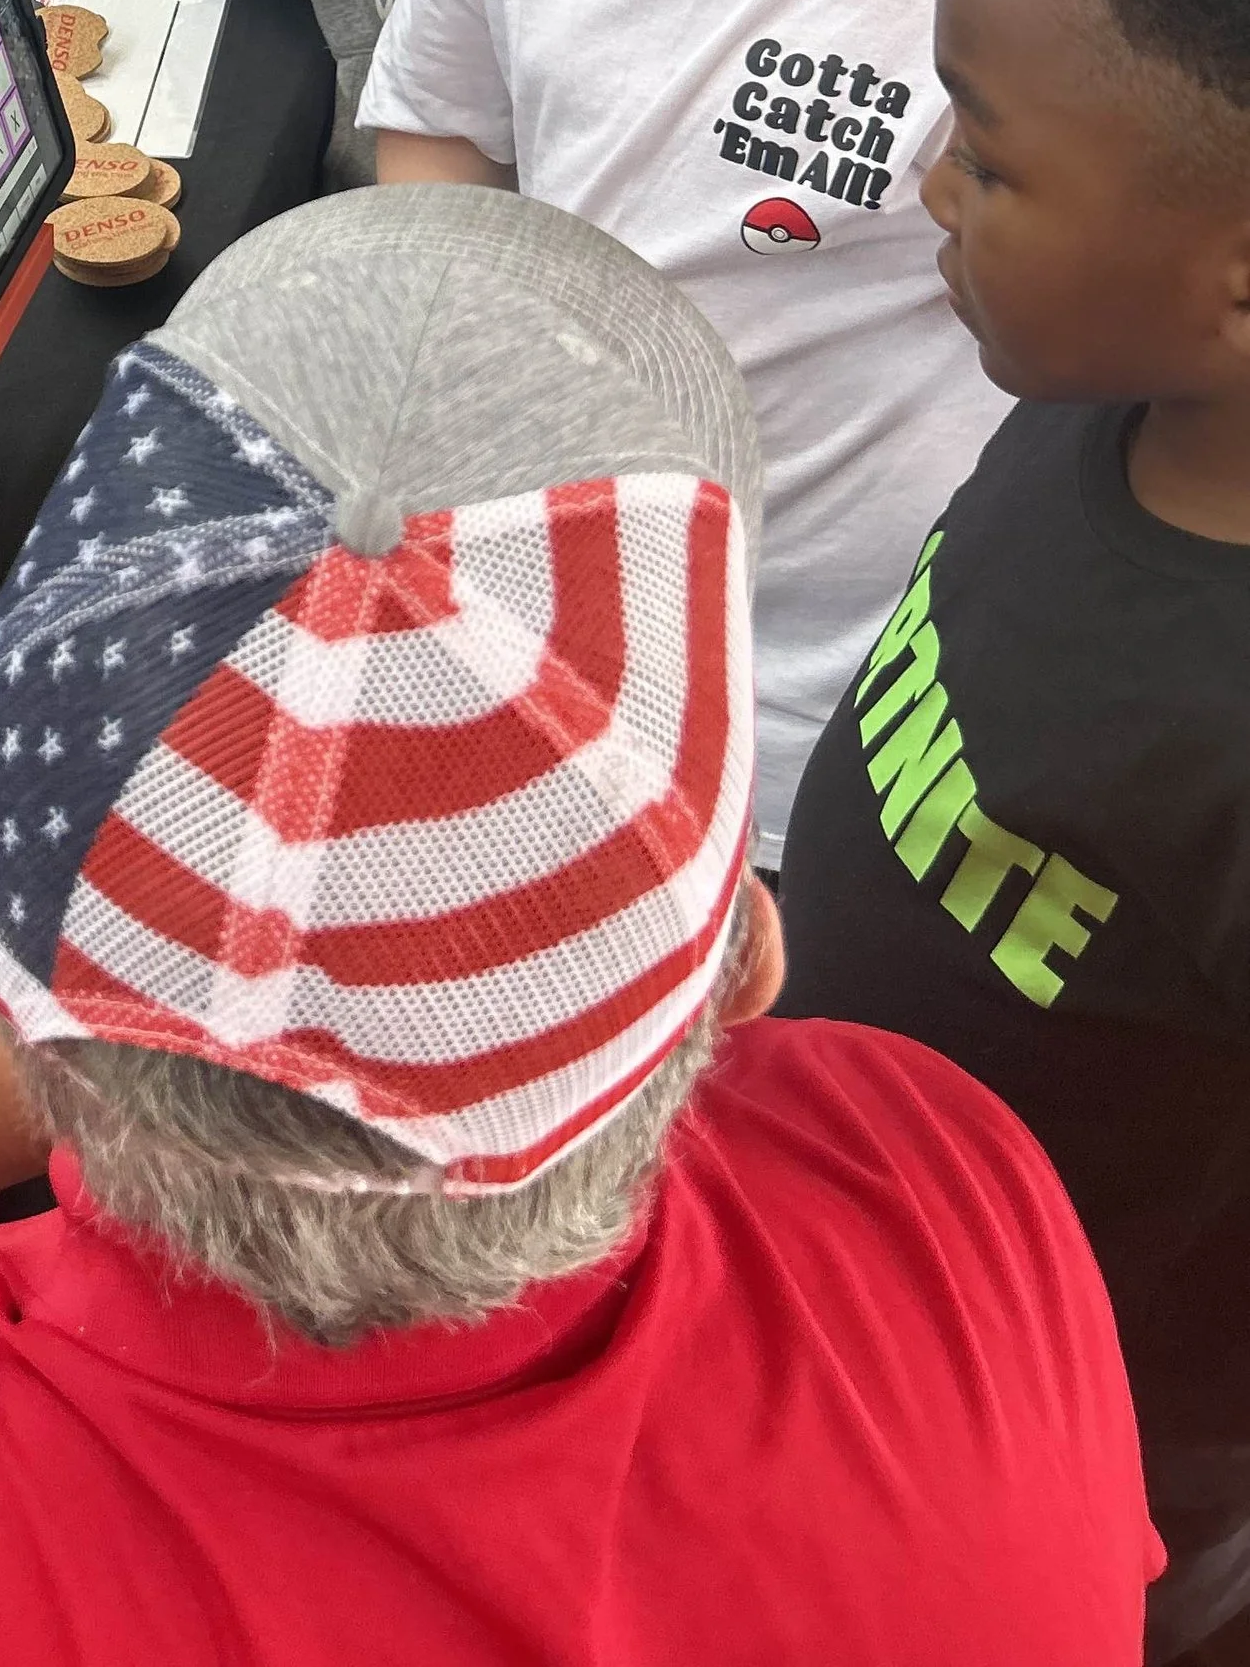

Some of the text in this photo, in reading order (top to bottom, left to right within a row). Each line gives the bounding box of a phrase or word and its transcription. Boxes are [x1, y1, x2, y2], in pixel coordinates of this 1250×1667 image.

[52, 13, 76, 72] DENSO
[745, 38, 911, 119] Gotta
[732, 81, 895, 164] Catch
[76, 159, 139, 171] ENSO
[713, 118, 893, 211] 'Em All!
[64, 209, 146, 243] DENSO
